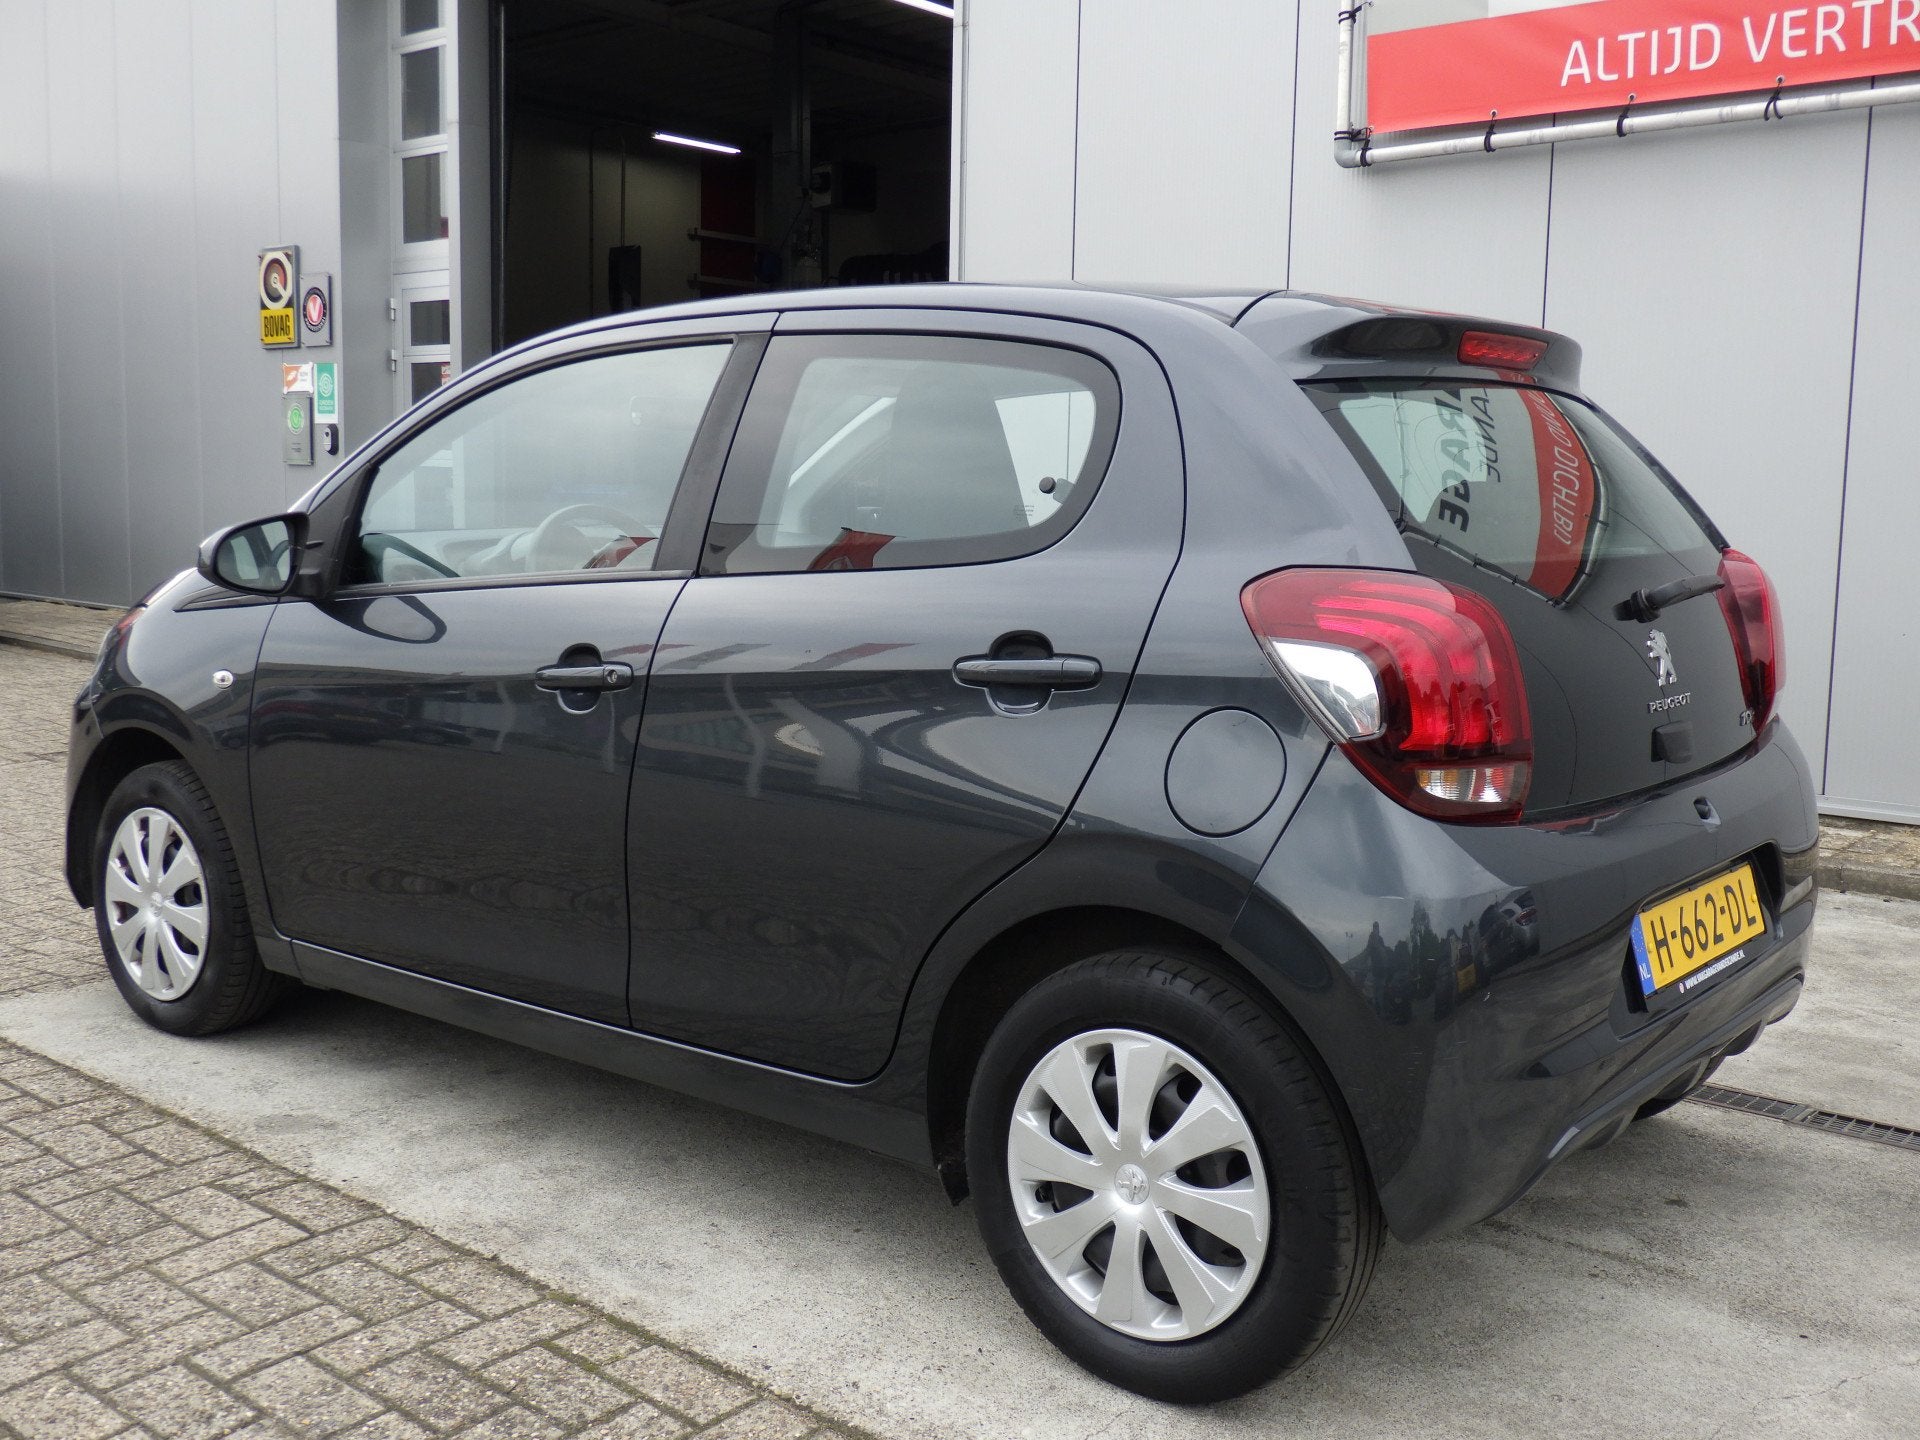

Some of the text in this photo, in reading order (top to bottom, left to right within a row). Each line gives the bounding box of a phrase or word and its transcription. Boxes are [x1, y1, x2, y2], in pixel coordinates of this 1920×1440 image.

[1560, 0, 1920, 87] ALTIJD VERTR
[263, 314, 291, 338] BOVAG
[1648, 692, 1691, 714] PEUGEOT
[1650, 879, 1757, 973] H-662-DL
[1639, 962, 1651, 981] NL
